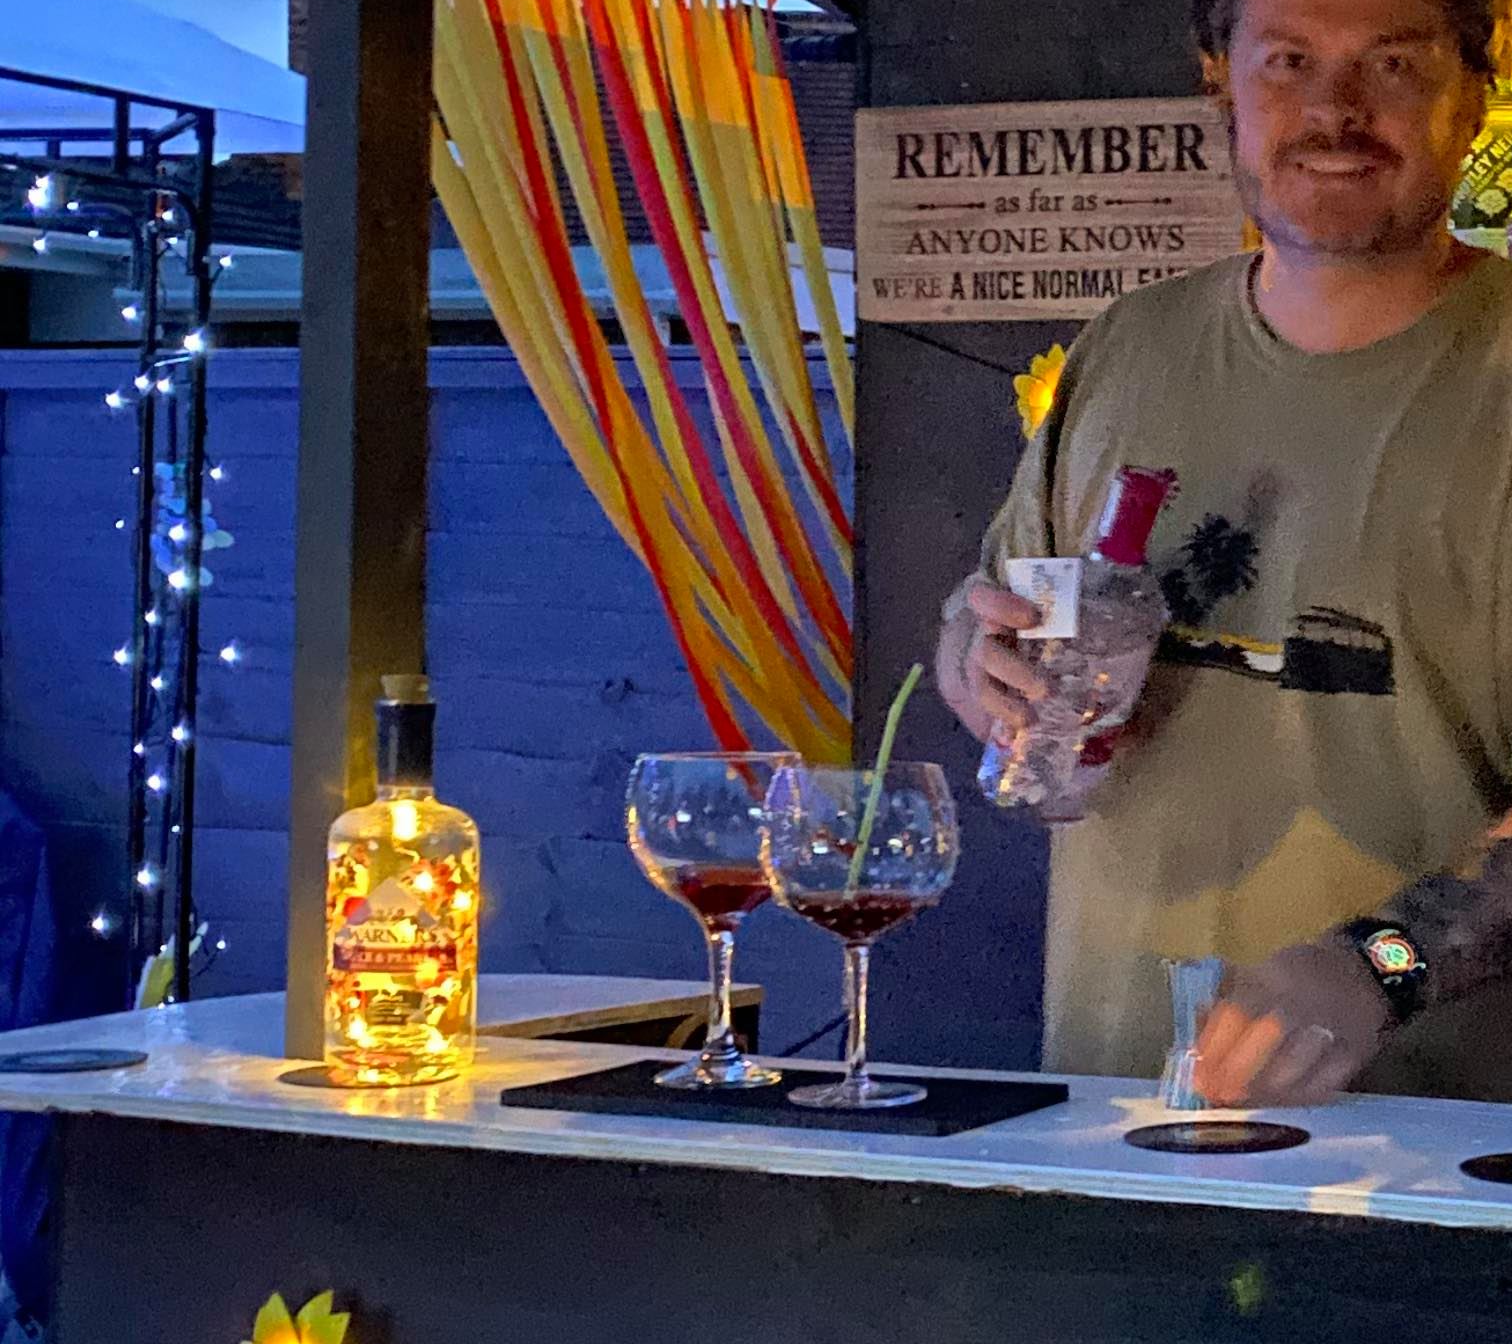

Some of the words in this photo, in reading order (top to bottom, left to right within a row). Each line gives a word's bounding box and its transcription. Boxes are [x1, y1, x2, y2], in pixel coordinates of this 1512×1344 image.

[892, 122, 1208, 180] REMEMBER
[994, 194, 1020, 213] as
[1025, 187, 1066, 212] far
[1072, 192, 1097, 212] as
[906, 227, 1049, 256] ANYONE
[1058, 224, 1186, 253] KNOWS
[873, 276, 942, 299] WE'RE
[949, 271, 967, 301] A
[972, 270, 1025, 300] NICE
